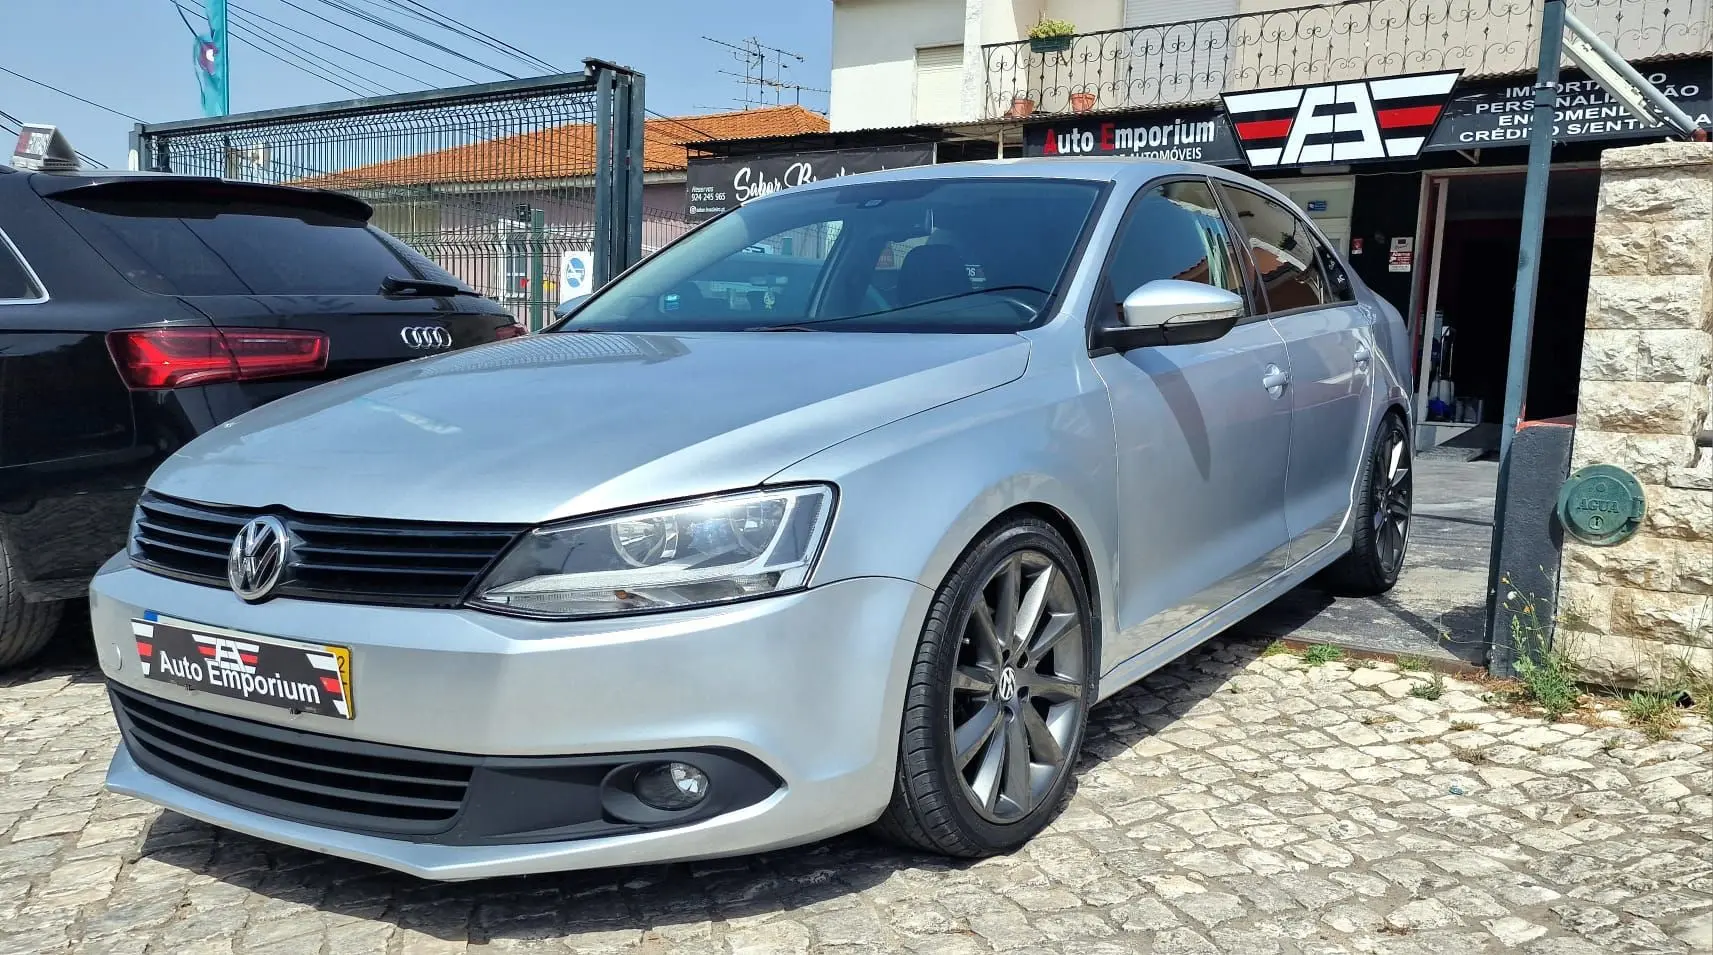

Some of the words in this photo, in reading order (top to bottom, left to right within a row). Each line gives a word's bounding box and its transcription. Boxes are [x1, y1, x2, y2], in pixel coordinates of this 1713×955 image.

[1476, 85, 1699, 114] PERSNALIÃO
[1506, 73, 1667, 98] IMRTO
[1042, 127, 1094, 154] Auto
[1101, 119, 1215, 152] Emporium
[1459, 126, 1560, 142] CRÉDI
[1566, 113, 1712, 135] S/ENTA
[160, 651, 203, 682] Auto
[207, 663, 321, 704] Emporium
